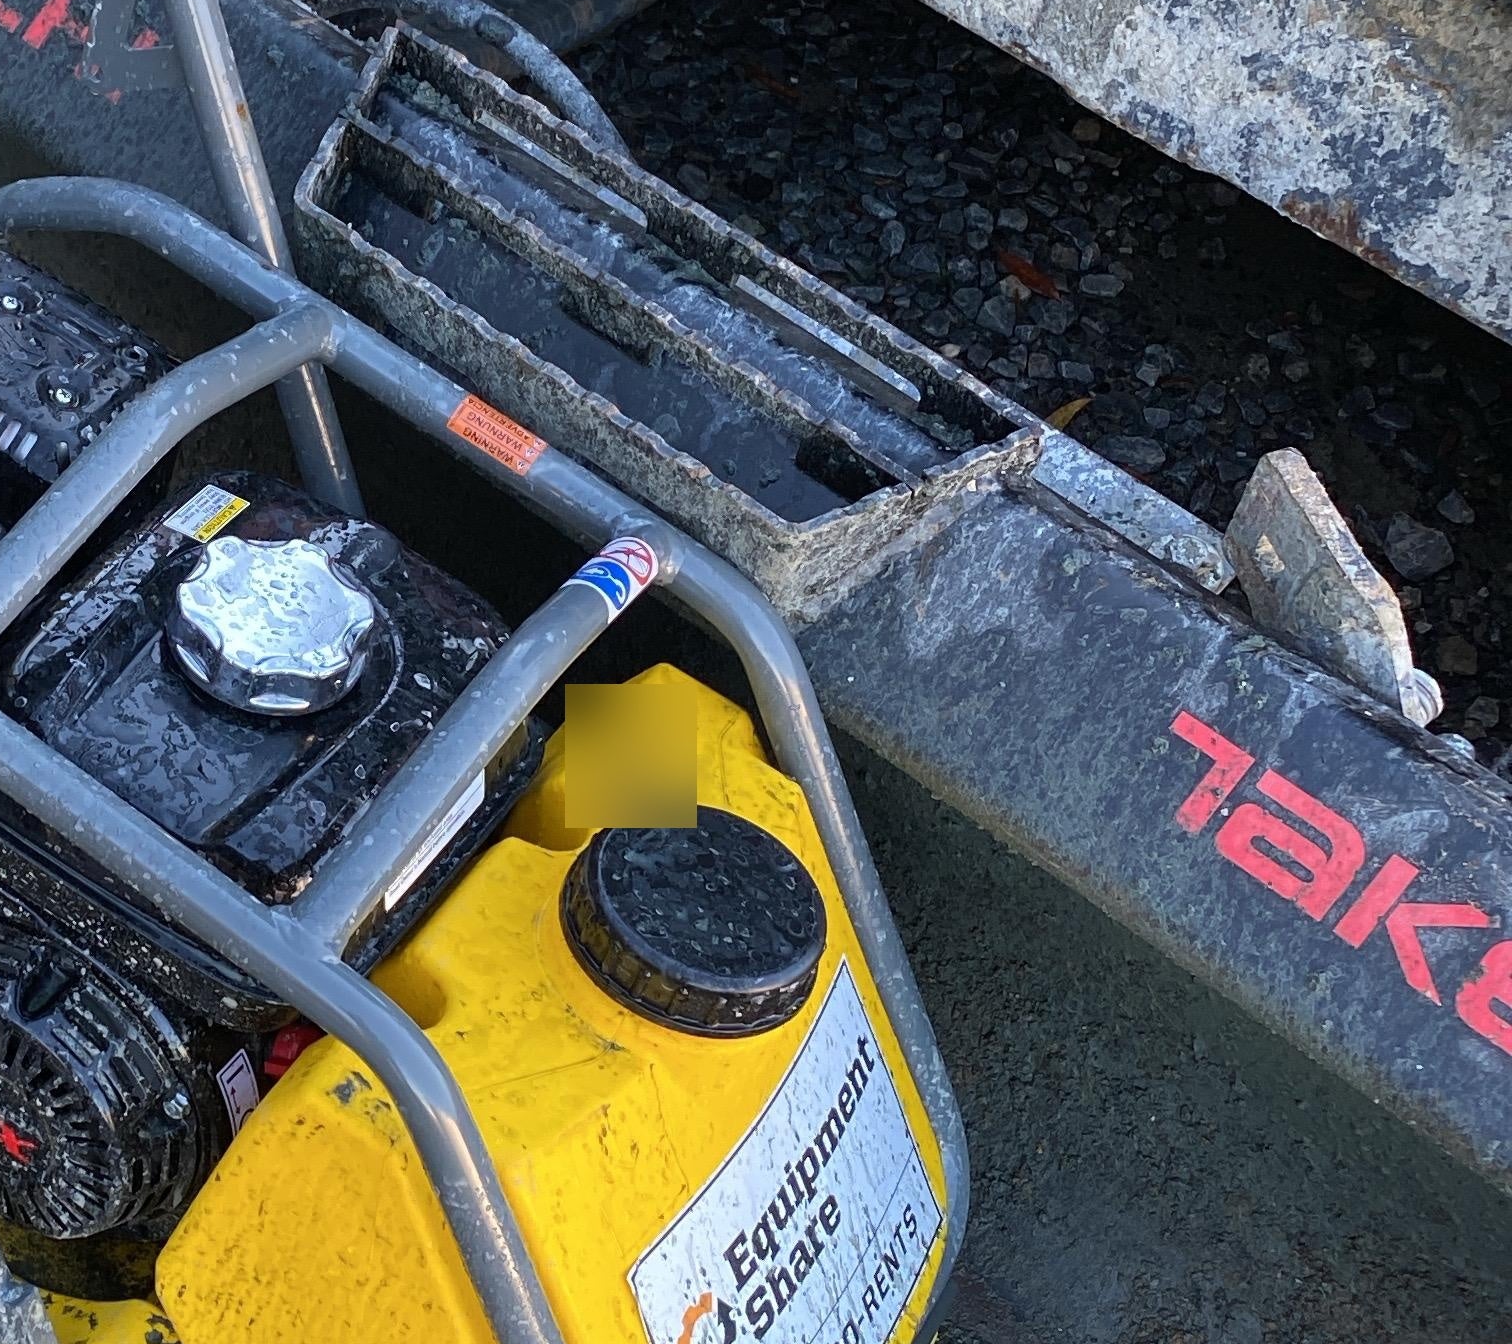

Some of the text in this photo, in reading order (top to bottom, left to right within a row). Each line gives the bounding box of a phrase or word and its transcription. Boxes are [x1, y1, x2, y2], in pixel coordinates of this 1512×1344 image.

[462, 427, 515, 466] WARNING
[467, 411, 522, 452] WARNUNG
[723, 1036, 876, 1292] Equipment
[744, 1193, 841, 1341] Share
